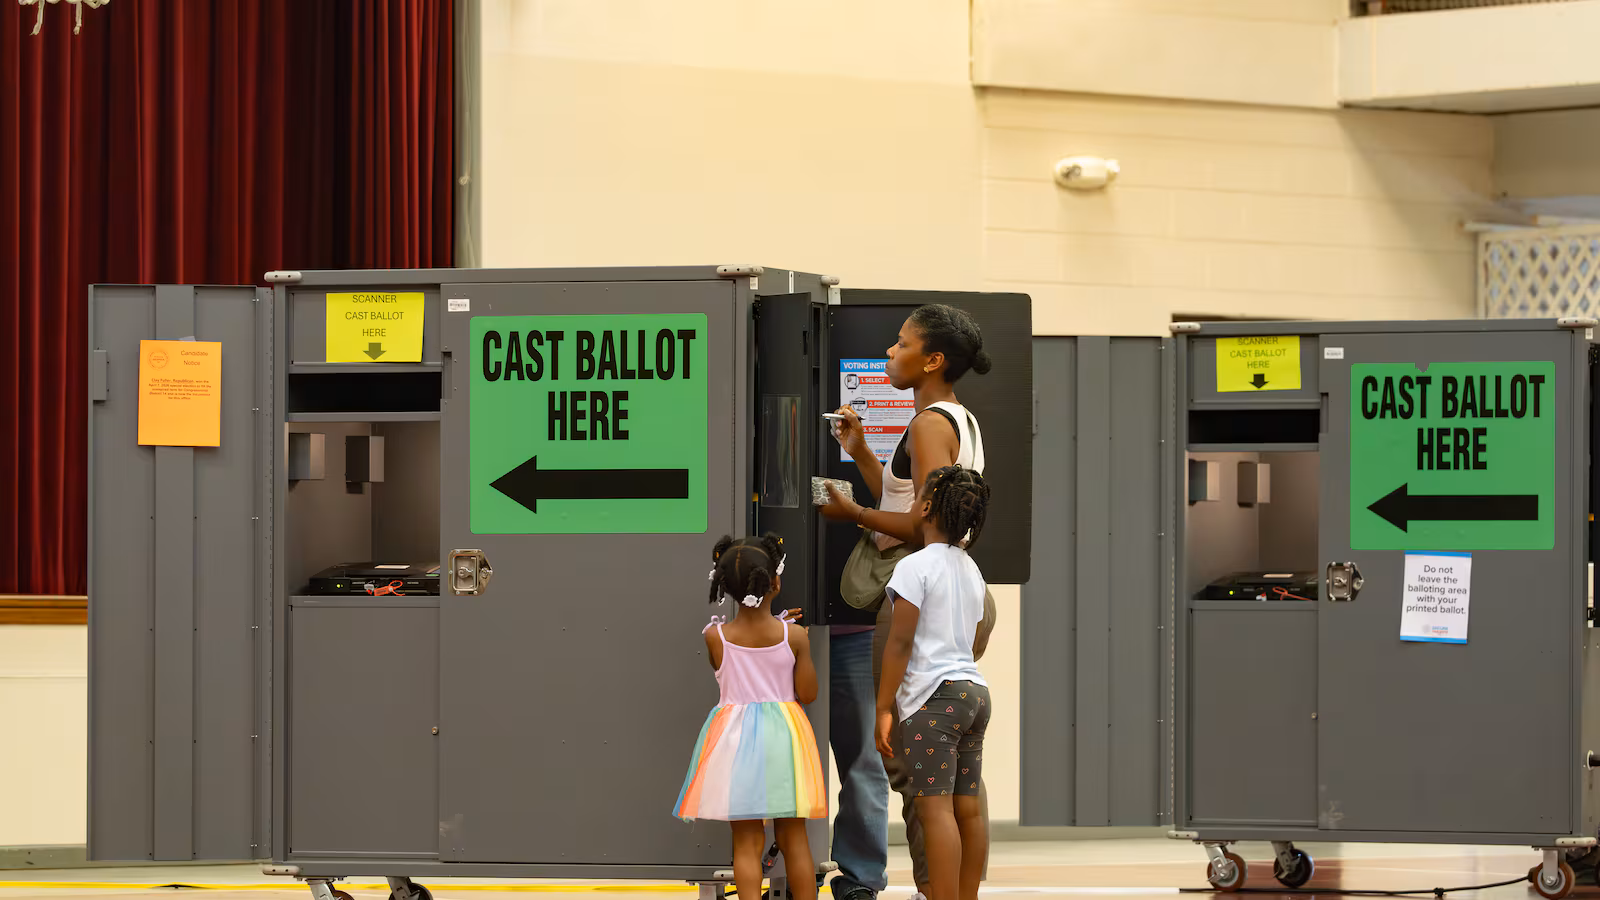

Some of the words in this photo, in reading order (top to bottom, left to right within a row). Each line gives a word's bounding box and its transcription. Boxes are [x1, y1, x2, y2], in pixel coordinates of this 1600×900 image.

[352, 294, 397, 303] SCANNER
[345, 311, 369, 320] CAST
[371, 311, 404, 320] BALLOT
[362, 328, 387, 337] HERE
[1237, 336, 1279, 346] SCANNER
[482, 329, 565, 382] CAST
[576, 328, 697, 381] BALLOT
[1230, 349, 1252, 358] CAST
[1255, 348, 1287, 357] BALLOT
[843, 362, 869, 370] VOTING
[1247, 360, 1270, 369] HERE
[1361, 375, 1432, 420] CAST
[1441, 374, 1546, 419] BALLOT
[547, 390, 629, 441] HERE
[1417, 427, 1488, 471] HERE
[1423, 564, 1436, 573] Do
[1438, 566, 1453, 574] not
[1417, 574, 1441, 583] leave
[1443, 576, 1458, 584] the
[1407, 584, 1446, 595] balloting
[1447, 587, 1467, 595] area
[1416, 594, 1435, 603] with
[1437, 597, 1458, 605] your
[1406, 604, 1438, 613] printed
[1440, 605, 1466, 614] ballot.
